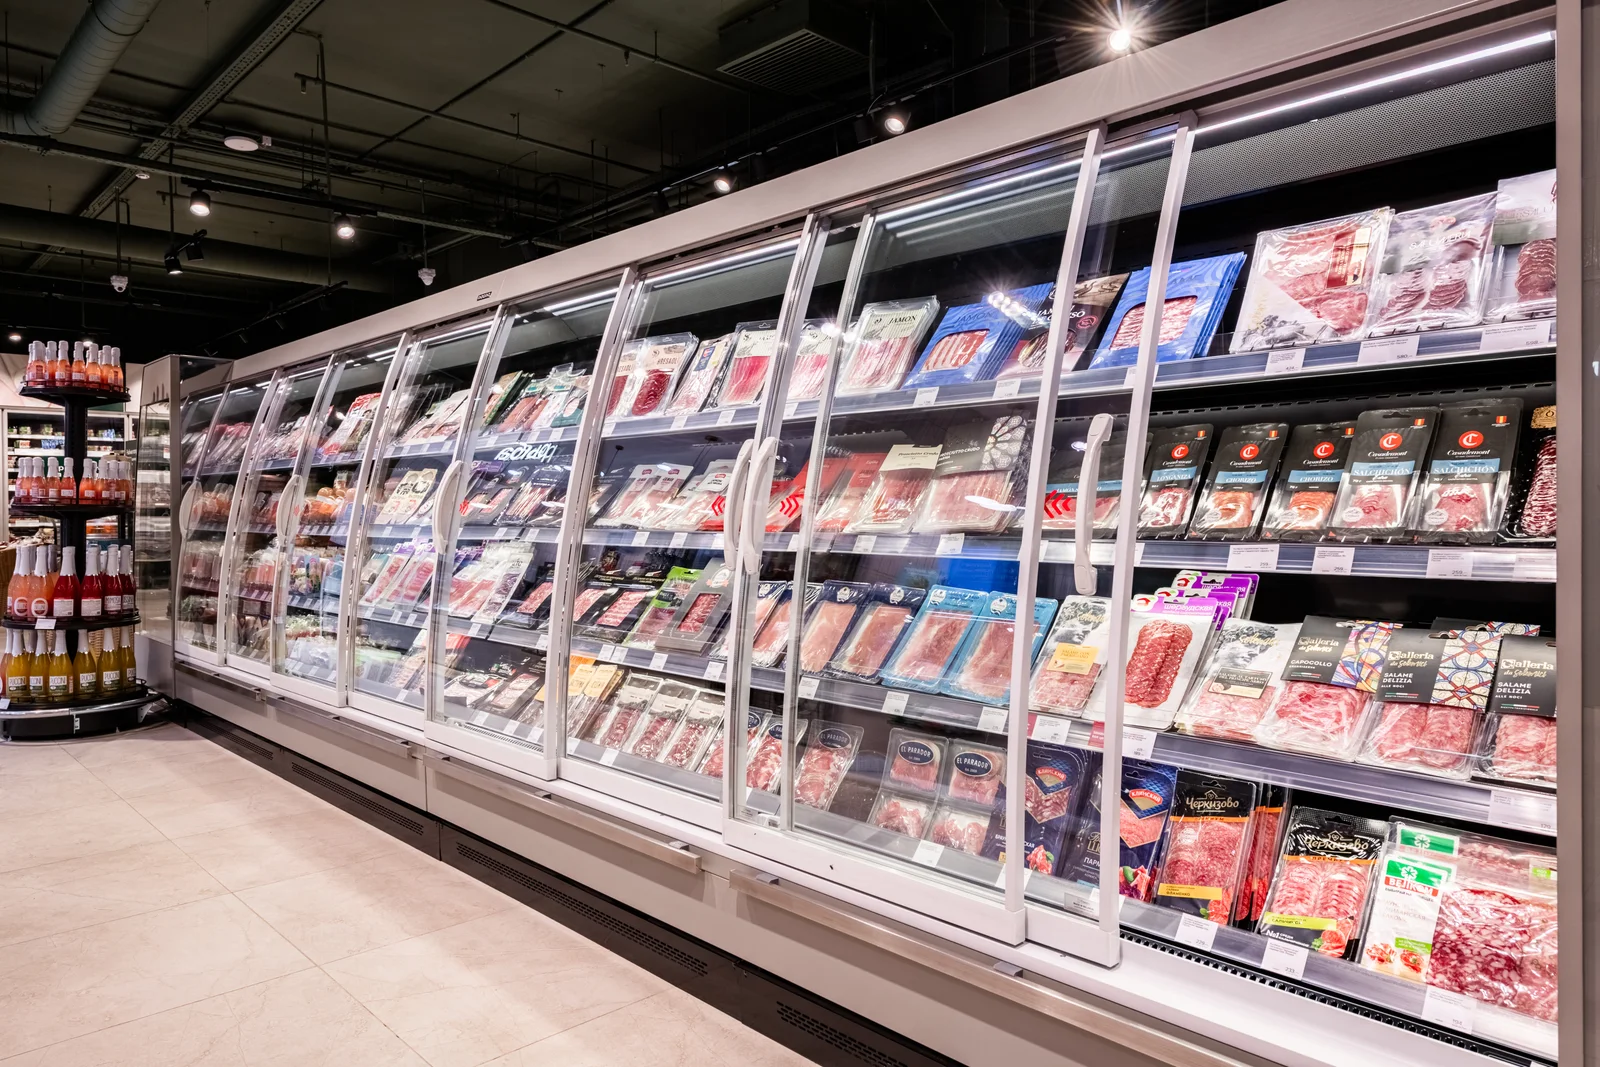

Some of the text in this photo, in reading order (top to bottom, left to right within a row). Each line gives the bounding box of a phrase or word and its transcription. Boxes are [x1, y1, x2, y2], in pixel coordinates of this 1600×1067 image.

[1433, 464, 1496, 474] SALCHICHÓN
[1225, 476, 1257, 484] CHORIZO
[1299, 475, 1334, 483] CHORIZO
[1387, 650, 1434, 661] Galleria
[1290, 660, 1333, 668] CAPOCOLLO
[1500, 658, 1554, 670] Galleria
[1497, 681, 1532, 689] SALAME
[1496, 687, 1531, 695] DELIZIA
[900, 744, 932, 759] EL PARADOR
[956, 756, 989, 770] EL PARADOR
[1185, 796, 1240, 811] Черкизово
